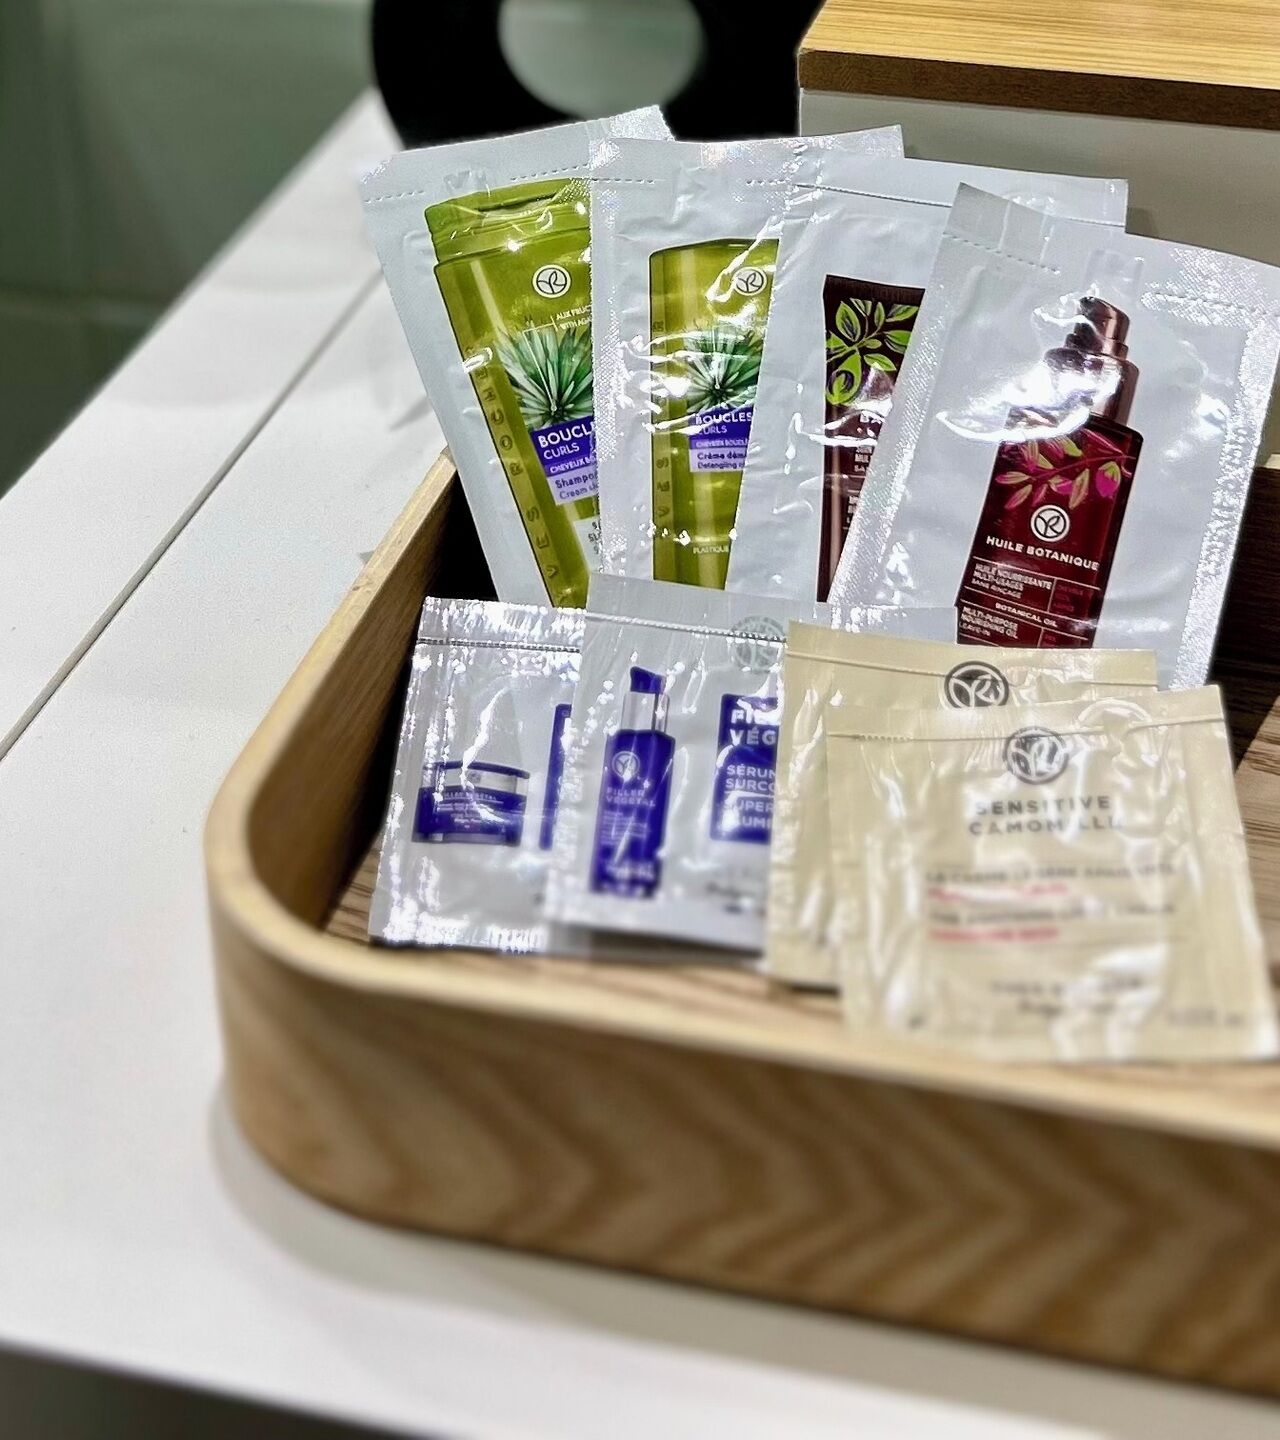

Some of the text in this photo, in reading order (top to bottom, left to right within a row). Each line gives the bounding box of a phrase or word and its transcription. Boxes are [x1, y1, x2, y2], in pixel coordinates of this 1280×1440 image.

[695, 412, 752, 425] BOUCLES
[538, 421, 595, 449] BOUCL
[543, 442, 580, 460] CURLS
[986, 535, 1101, 571] HUILE BOTANIQUE
[995, 602, 1043, 624] BOTANICAL
[1043, 617, 1059, 628] OIL
[729, 725, 777, 747] VÉG
[976, 795, 1112, 816] SENSITIVE
[968, 814, 1124, 836] CAMOMLL
